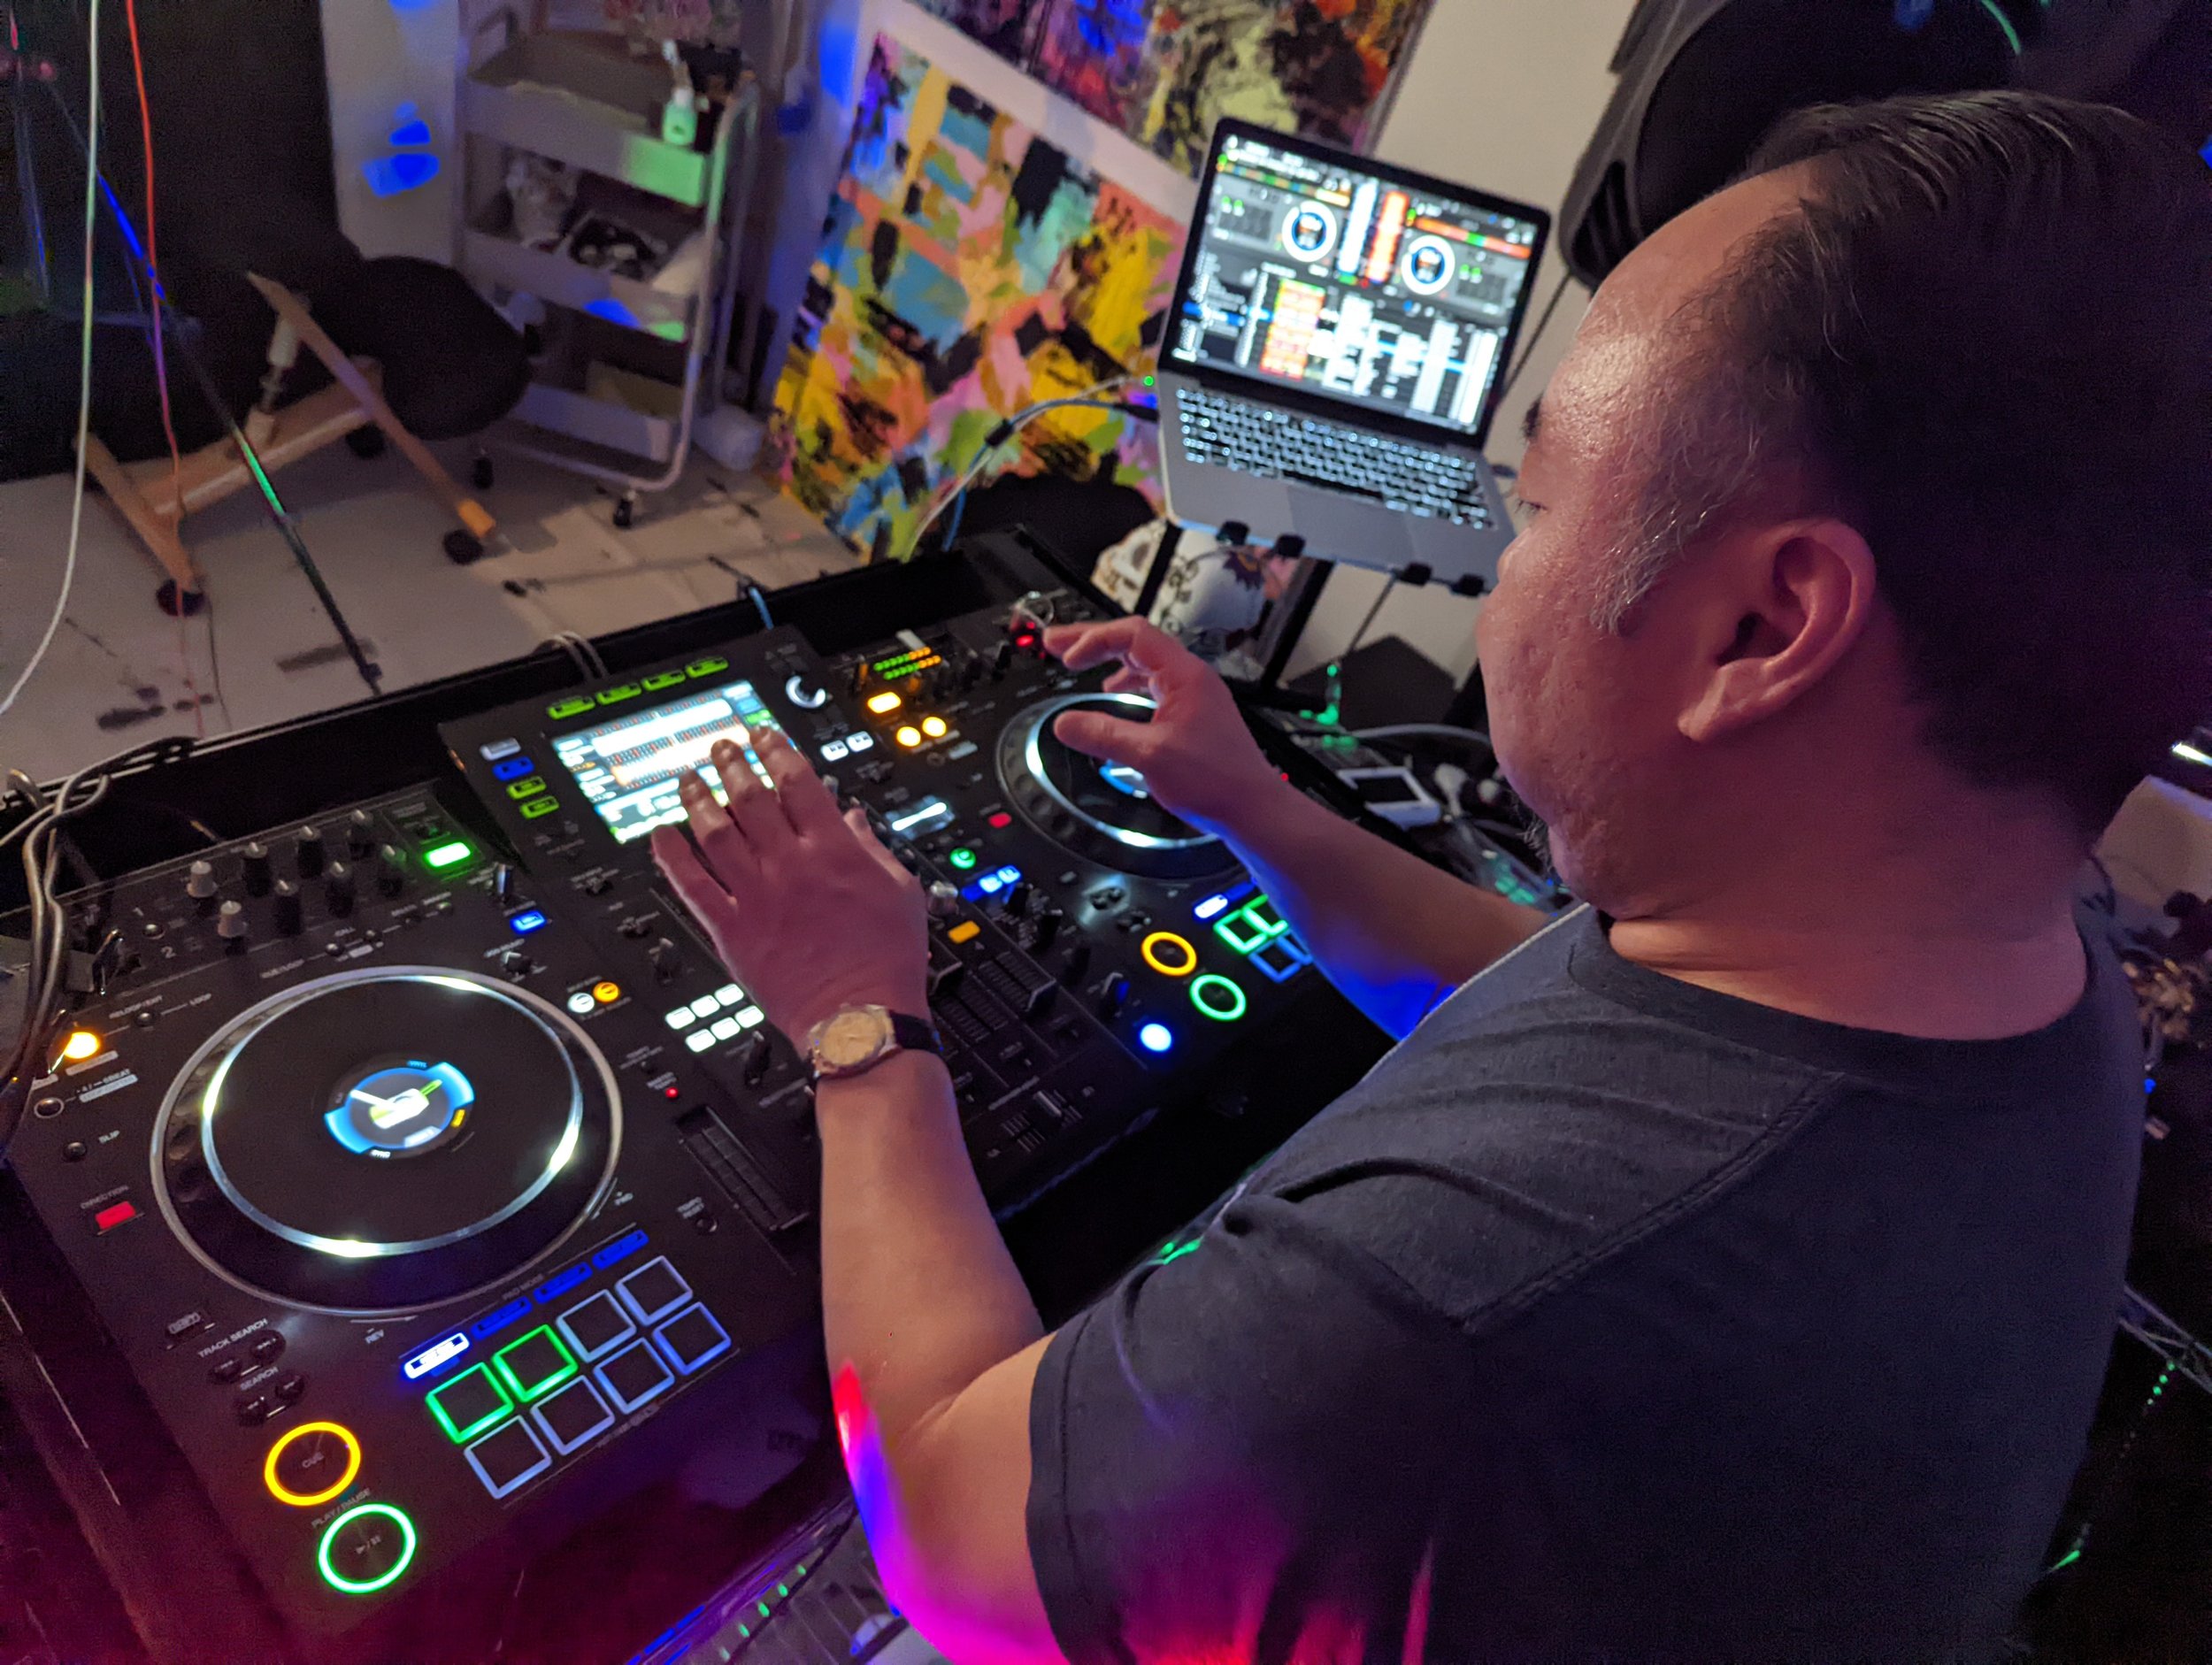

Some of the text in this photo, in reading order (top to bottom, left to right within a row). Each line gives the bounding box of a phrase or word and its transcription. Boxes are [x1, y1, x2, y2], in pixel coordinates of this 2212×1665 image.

[160, 946, 177, 959] 2
[80, 1185, 129, 1210] DIRECTION
[197, 1317, 269, 1359] TRACK SEARCH
[365, 1329, 385, 1345] REV
[240, 1366, 280, 1392] SEARCH
[302, 1451, 324, 1469] CUE
